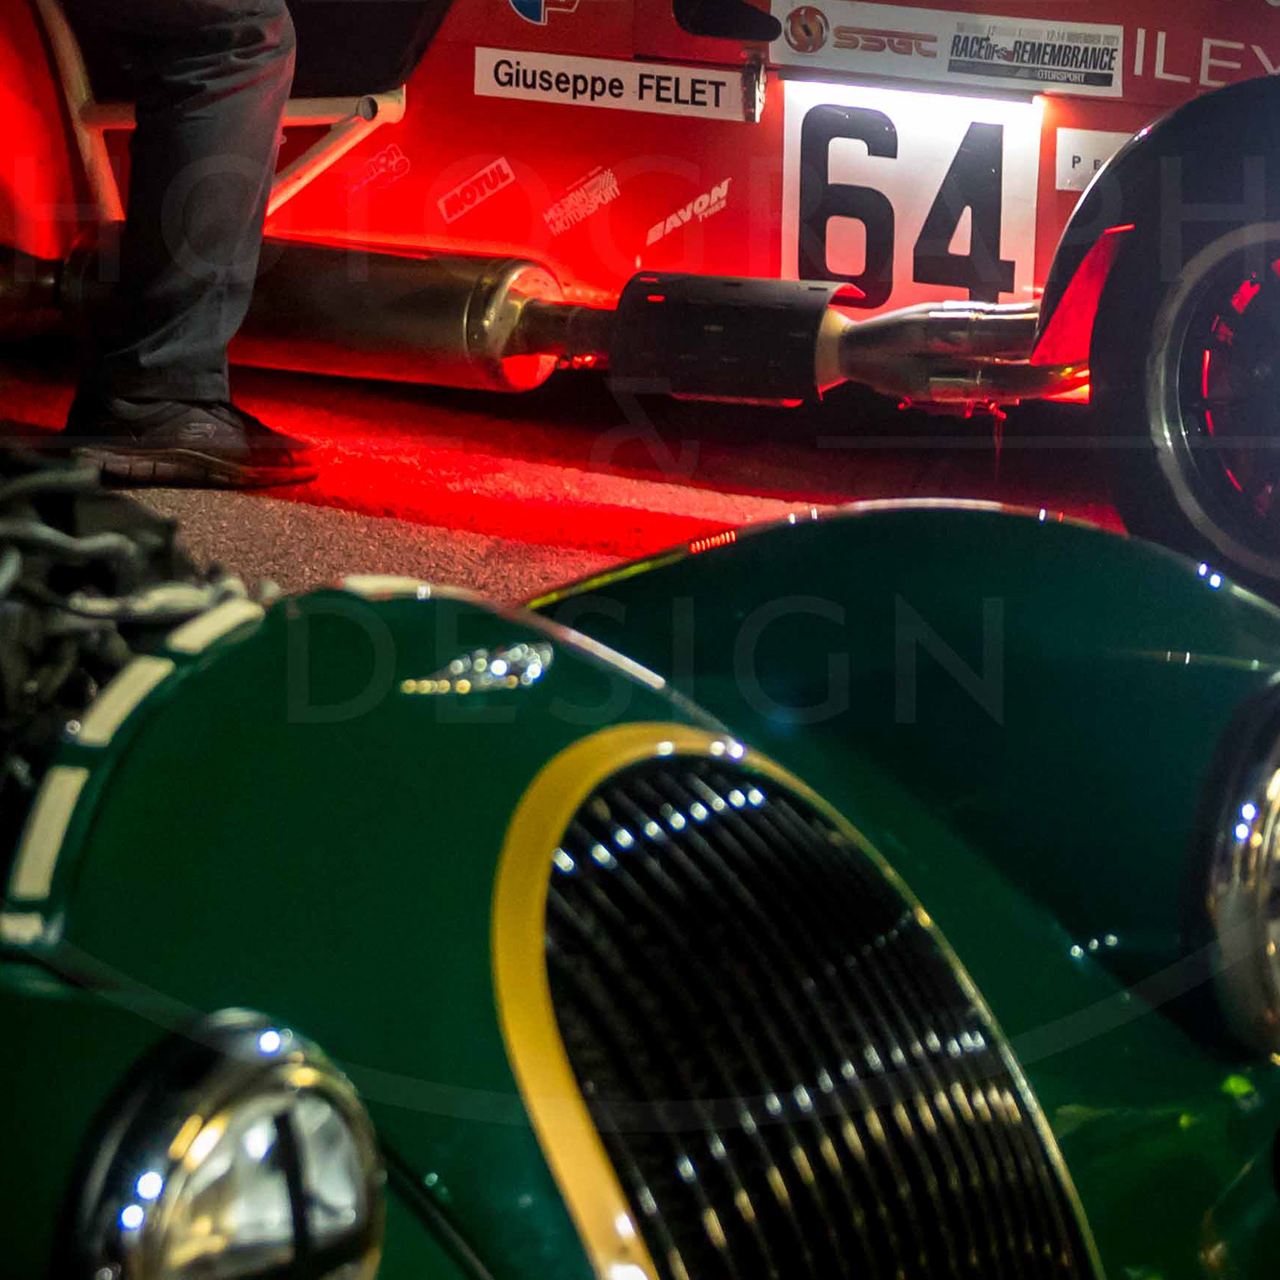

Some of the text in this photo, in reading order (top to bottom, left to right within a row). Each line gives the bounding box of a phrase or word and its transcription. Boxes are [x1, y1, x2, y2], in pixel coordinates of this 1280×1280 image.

[951, 34, 990, 60] RACE
[1011, 39, 1119, 71] REMEMBRANCE
[1037, 70, 1086, 84] OTORSPORT
[493, 59, 727, 108] Giuseppe FELET
[443, 163, 511, 219] MOTUL
[663, 177, 732, 234] AVON
[799, 103, 1016, 310] 64
